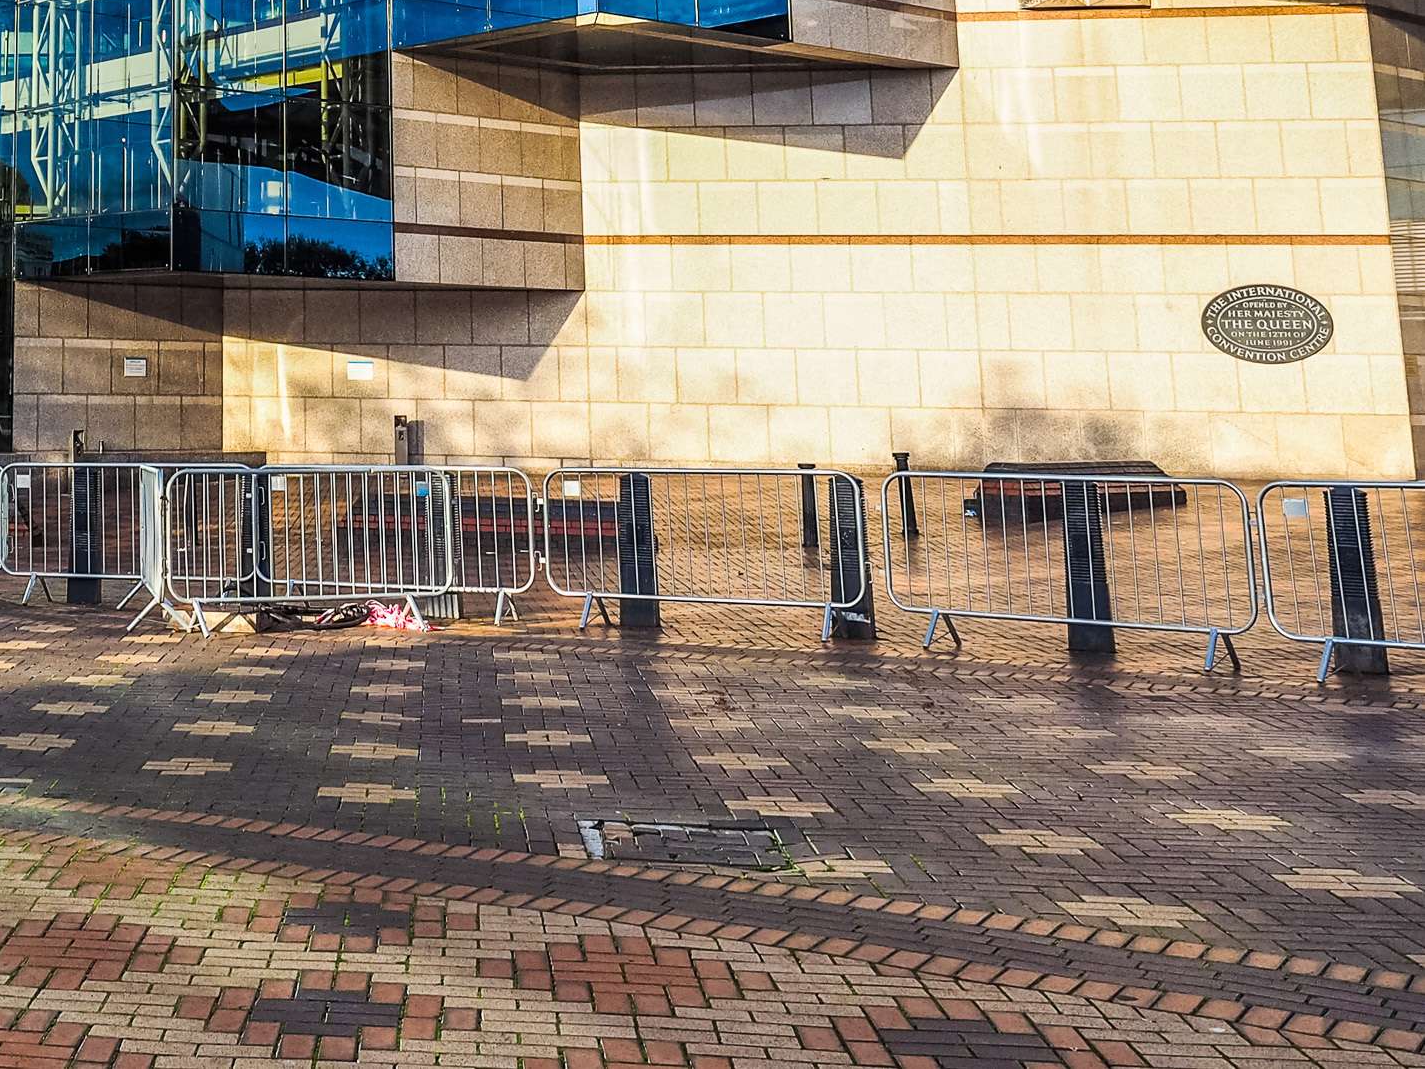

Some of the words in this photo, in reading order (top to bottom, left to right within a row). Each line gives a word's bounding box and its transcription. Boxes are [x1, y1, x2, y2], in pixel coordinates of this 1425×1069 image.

[1206, 298, 1227, 318] THE
[1228, 286, 1326, 320] INTERNATIONAL
[1242, 301, 1276, 309] OPENED
[1277, 301, 1288, 309] BY
[1227, 310, 1253, 318] HER
[1254, 310, 1305, 318] MAJESTY
[1221, 319, 1254, 329] THE
[1256, 319, 1313, 331] QUEEN
[1207, 326, 1286, 362] CONVENTION
[1289, 327, 1330, 360] CENTRE
[1245, 339, 1271, 347] JUNE
[1273, 339, 1293, 347] 1991
